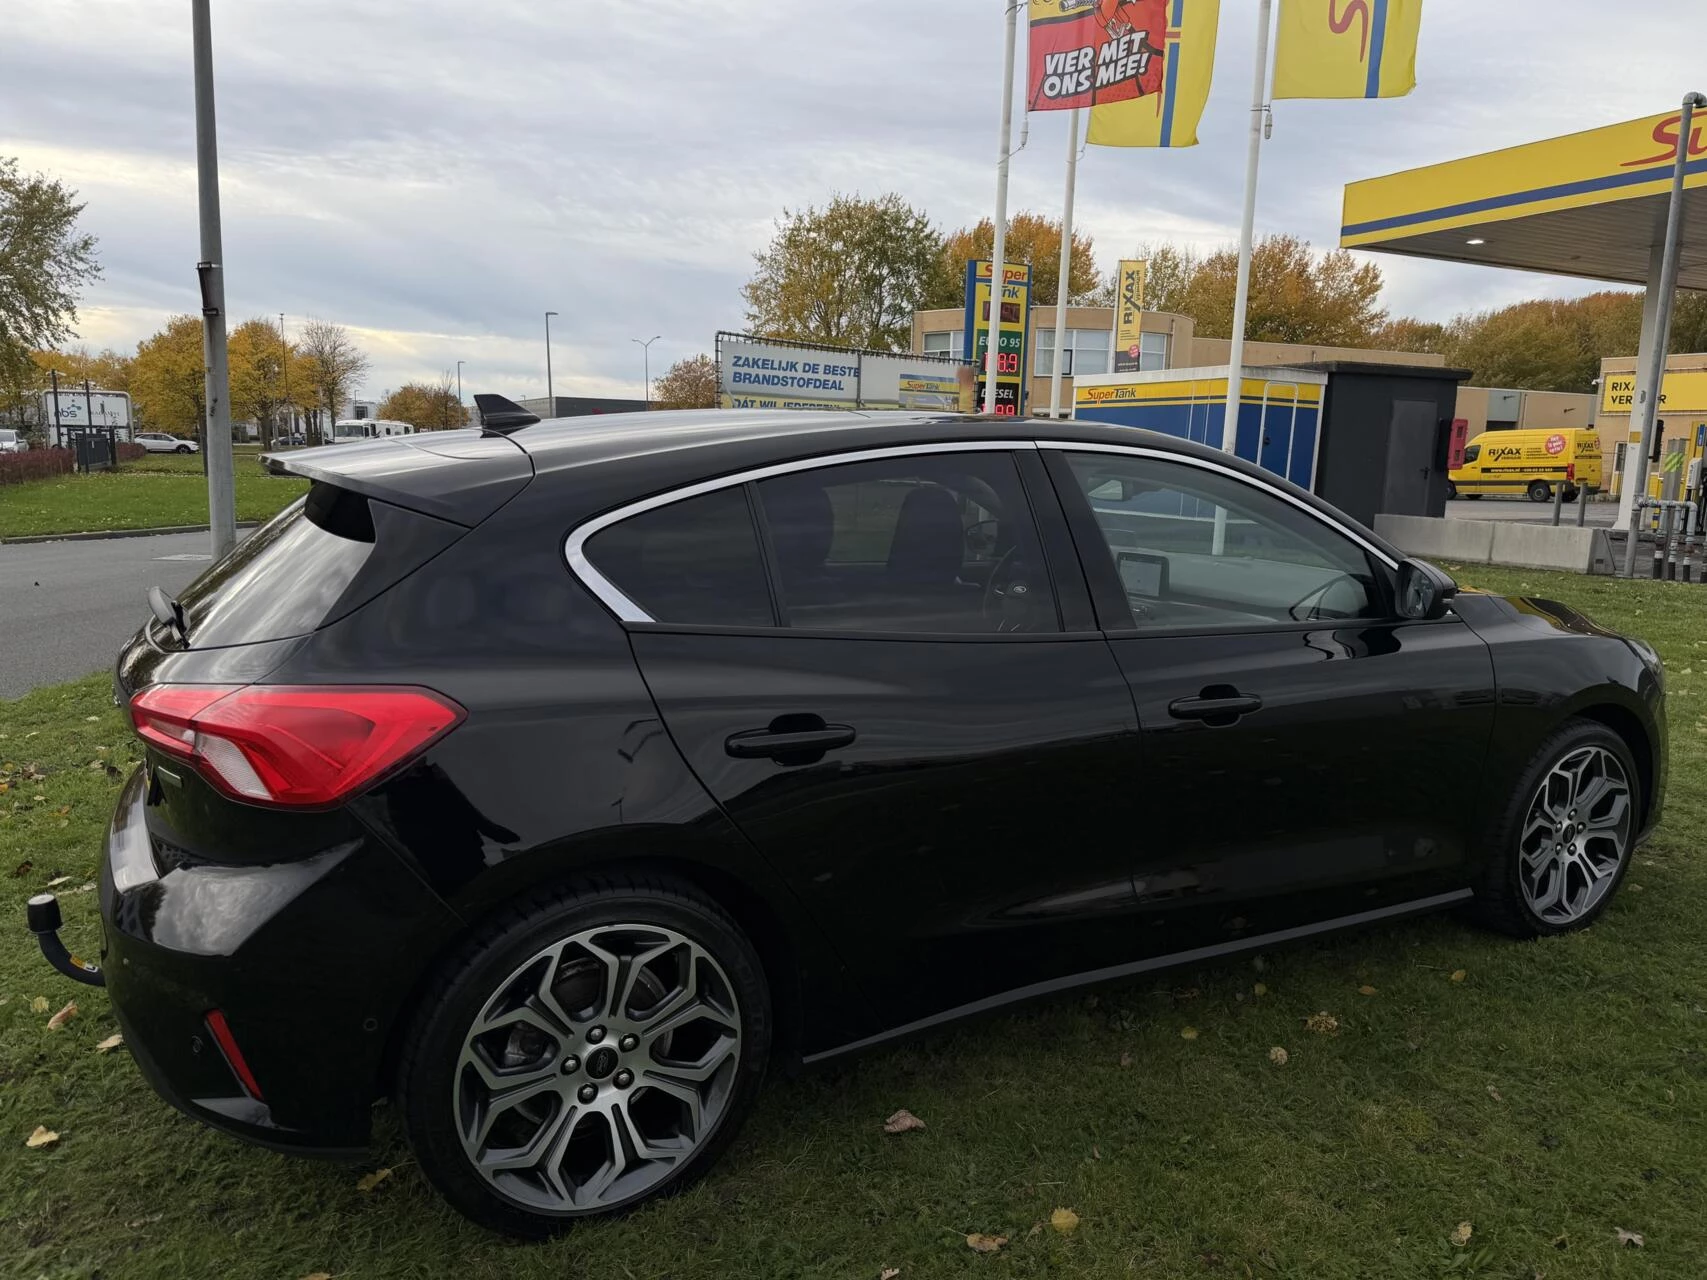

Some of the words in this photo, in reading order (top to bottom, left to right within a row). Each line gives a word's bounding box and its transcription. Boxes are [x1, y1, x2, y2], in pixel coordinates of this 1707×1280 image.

[1045, 46, 1094, 75] VIER
[1097, 31, 1148, 65] MET
[1043, 68, 1092, 97] ONS
[1095, 53, 1149, 87] MEE!
[977, 264, 1027, 284] Sper
[985, 284, 1018, 298] Tnk
[1123, 270, 1140, 325] RIXAX
[1009, 338, 1020, 348] 95
[732, 355, 798, 373] ZAKELIJK
[802, 362, 819, 375] DE
[823, 365, 860, 378] BESTE
[732, 371, 844, 391] BRANDSTOFDEAL
[1085, 388, 1136, 403] SuperTank
[1488, 446, 1522, 462] RIXAX
